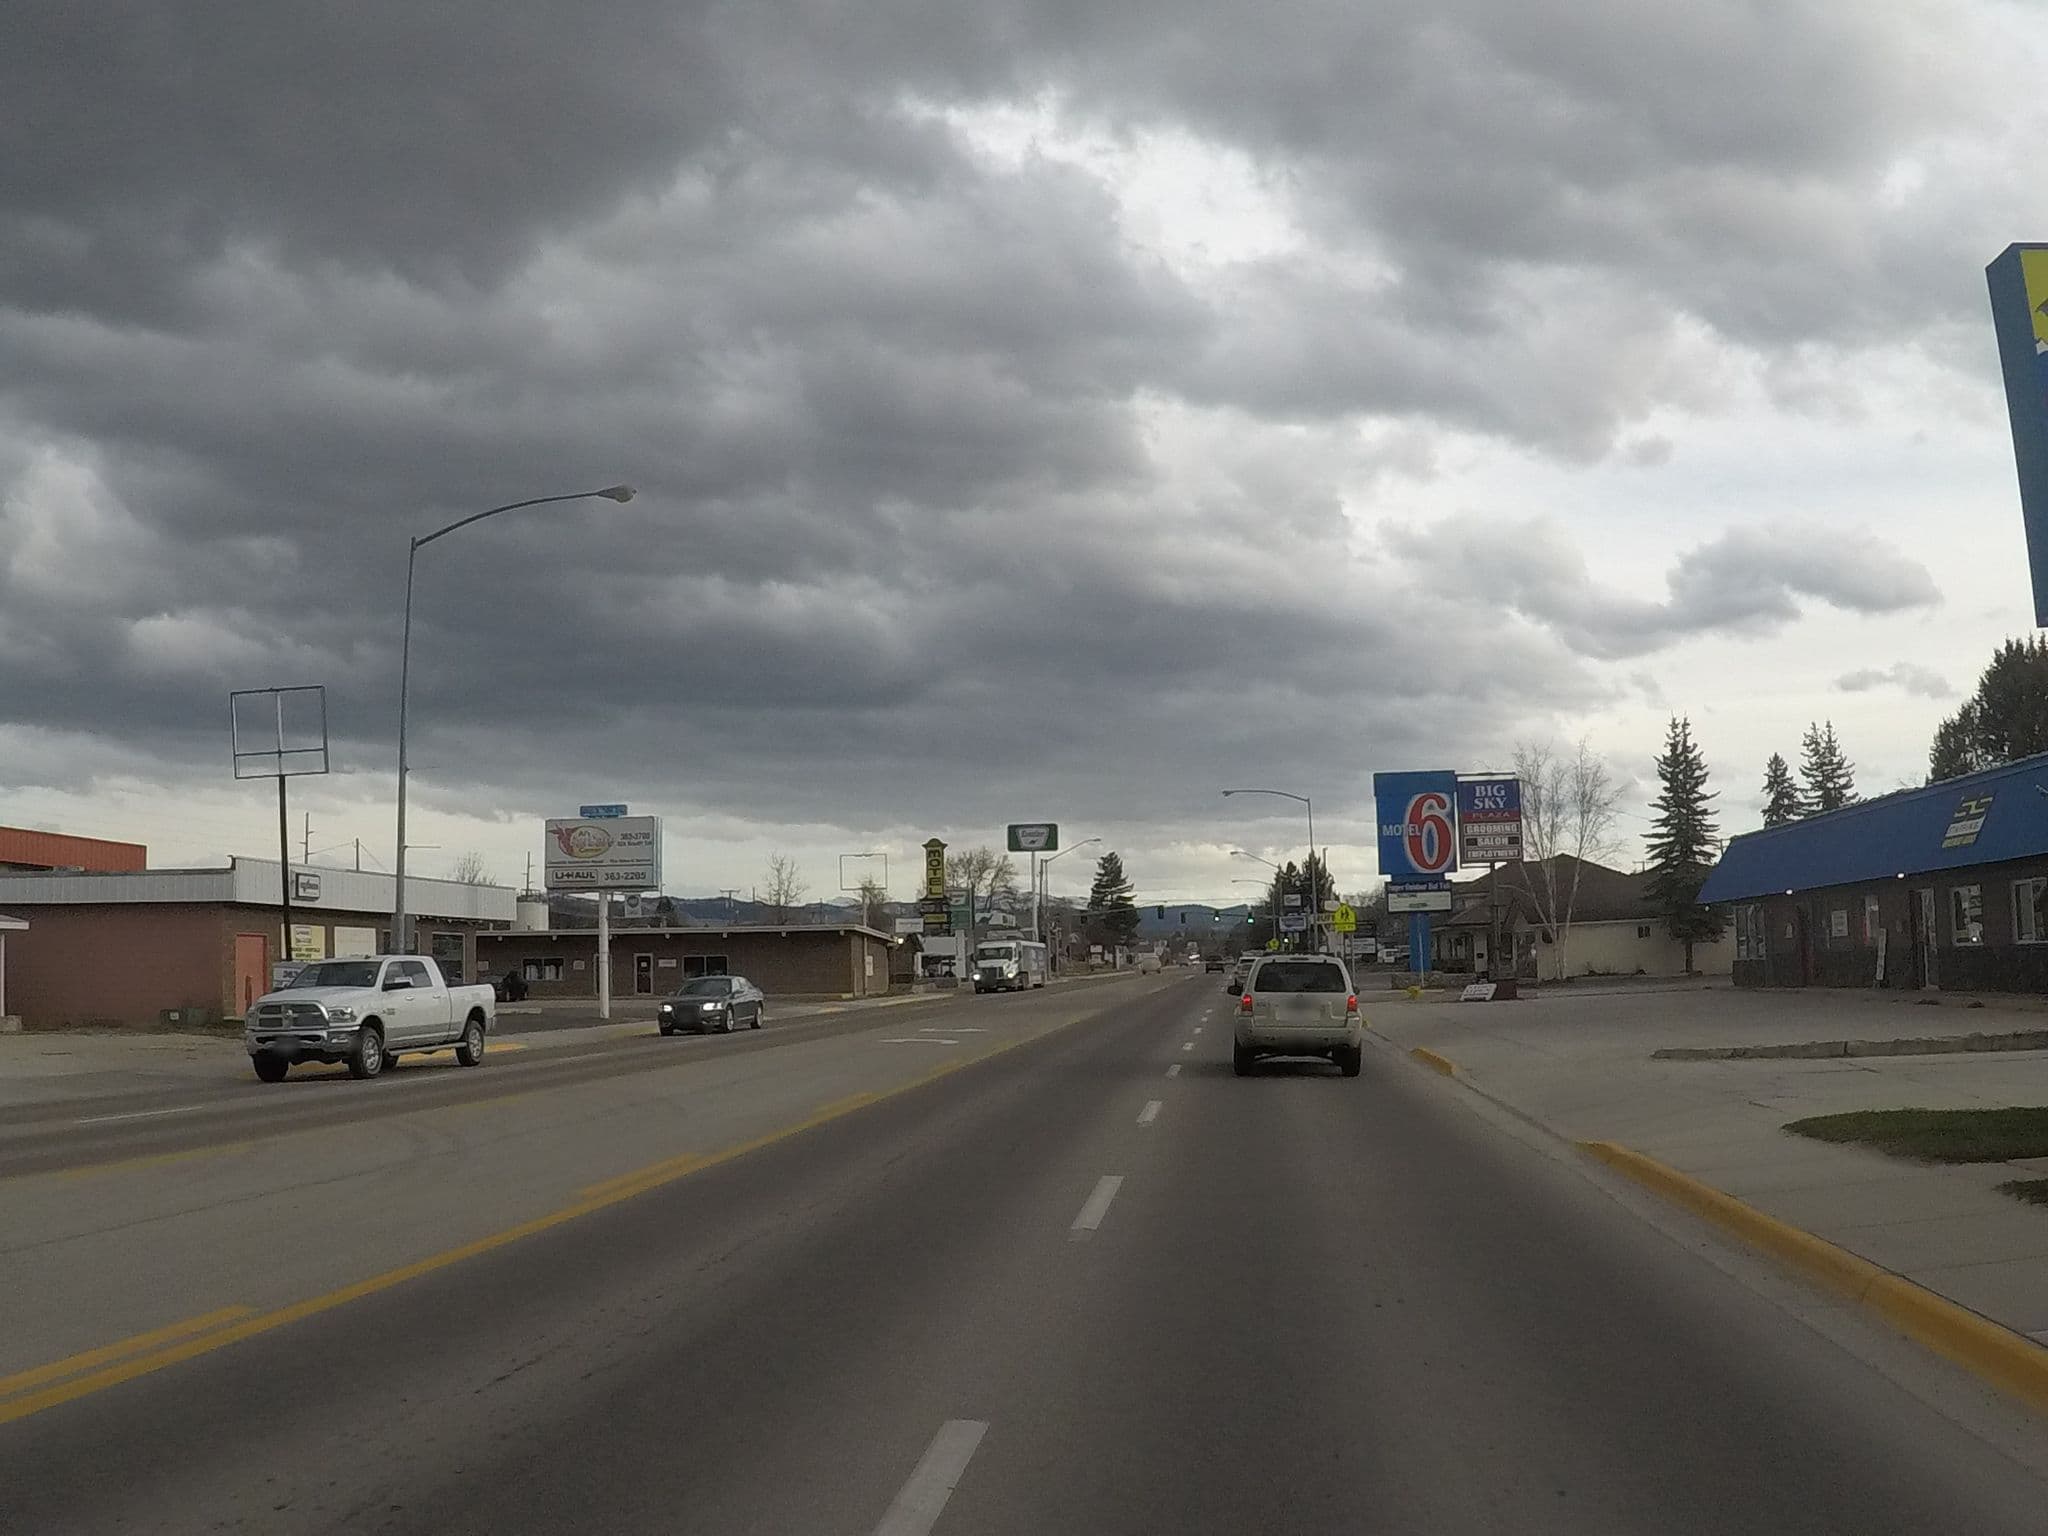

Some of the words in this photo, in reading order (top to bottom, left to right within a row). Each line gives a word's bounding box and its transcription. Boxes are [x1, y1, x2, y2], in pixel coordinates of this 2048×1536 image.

[1475, 784, 1506, 797] BIG
[1473, 797, 1507, 810] SKY
[1382, 824, 1421, 836] MOTEL
[1405, 793, 1453, 872] 6
[1466, 823, 1517, 833] GROOMING
[1477, 838, 1508, 847] SALON
[1467, 849, 1518, 858] EMPLOYMENT
[929, 849, 942, 896] MOTEL
